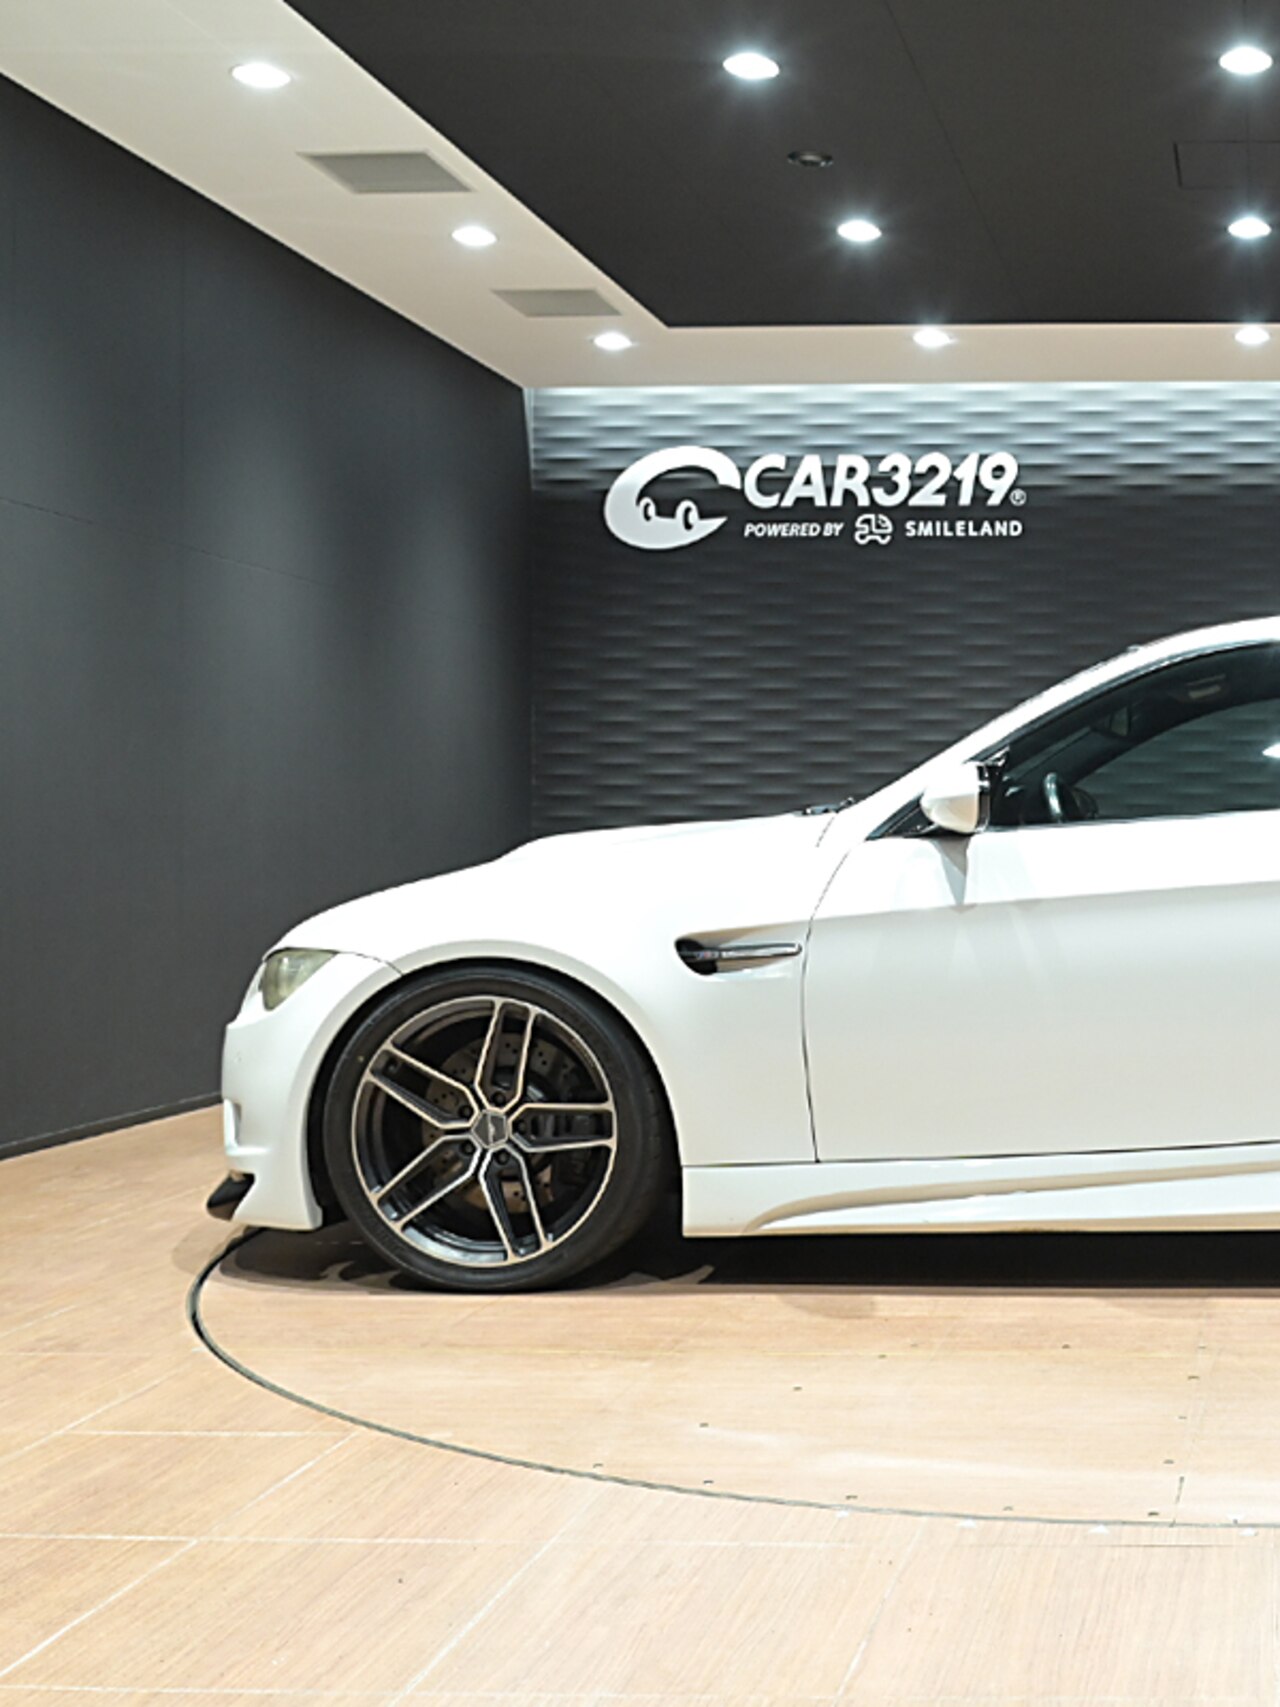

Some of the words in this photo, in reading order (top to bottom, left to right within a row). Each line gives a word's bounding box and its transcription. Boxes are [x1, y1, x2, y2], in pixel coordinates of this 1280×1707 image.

[743, 522, 821, 538] POWERED
[822, 522, 845, 537] BY
[905, 519, 1023, 537] SMILELAND
